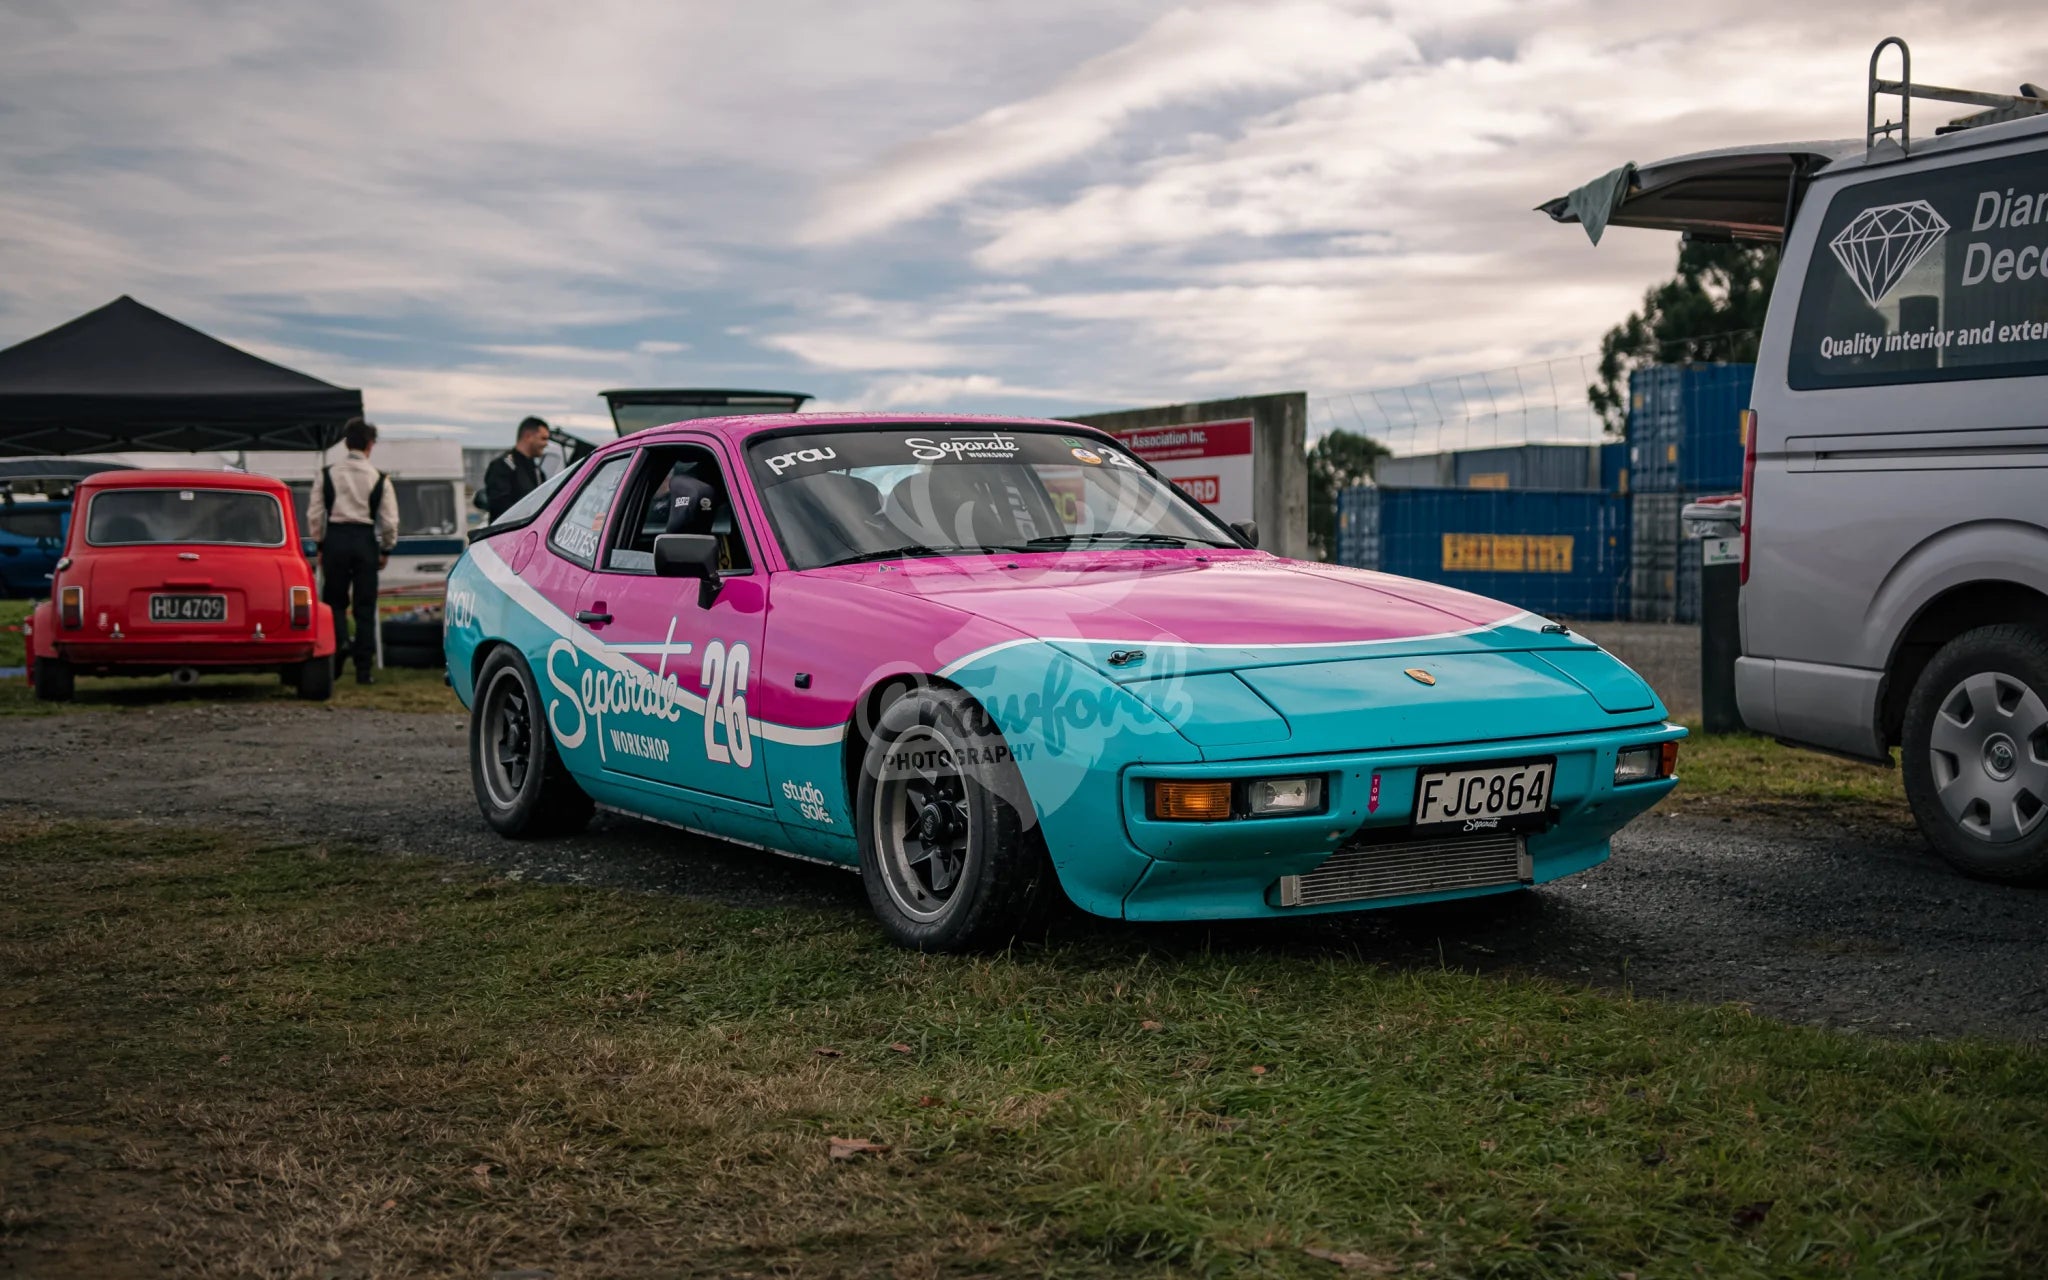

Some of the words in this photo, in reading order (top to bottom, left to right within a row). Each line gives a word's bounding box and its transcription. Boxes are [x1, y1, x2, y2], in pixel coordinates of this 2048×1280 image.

[1820, 332, 1882, 359] Quality
[1885, 326, 1955, 352] interior
[1957, 320, 1995, 346] and
[904, 433, 1020, 461] Separate
[1132, 432, 1187, 448] Association
[1190, 429, 1208, 445] Inc.
[765, 446, 837, 476] prau
[154, 598, 180, 618] HU
[181, 598, 223, 618] 4709
[547, 616, 693, 763] Separate
[701, 640, 753, 769] 26
[610, 729, 671, 763] WORKSHOP
[782, 779, 825, 806] studio
[1370, 778, 1379, 802] TOW
[1421, 770, 1545, 819] FJC864
